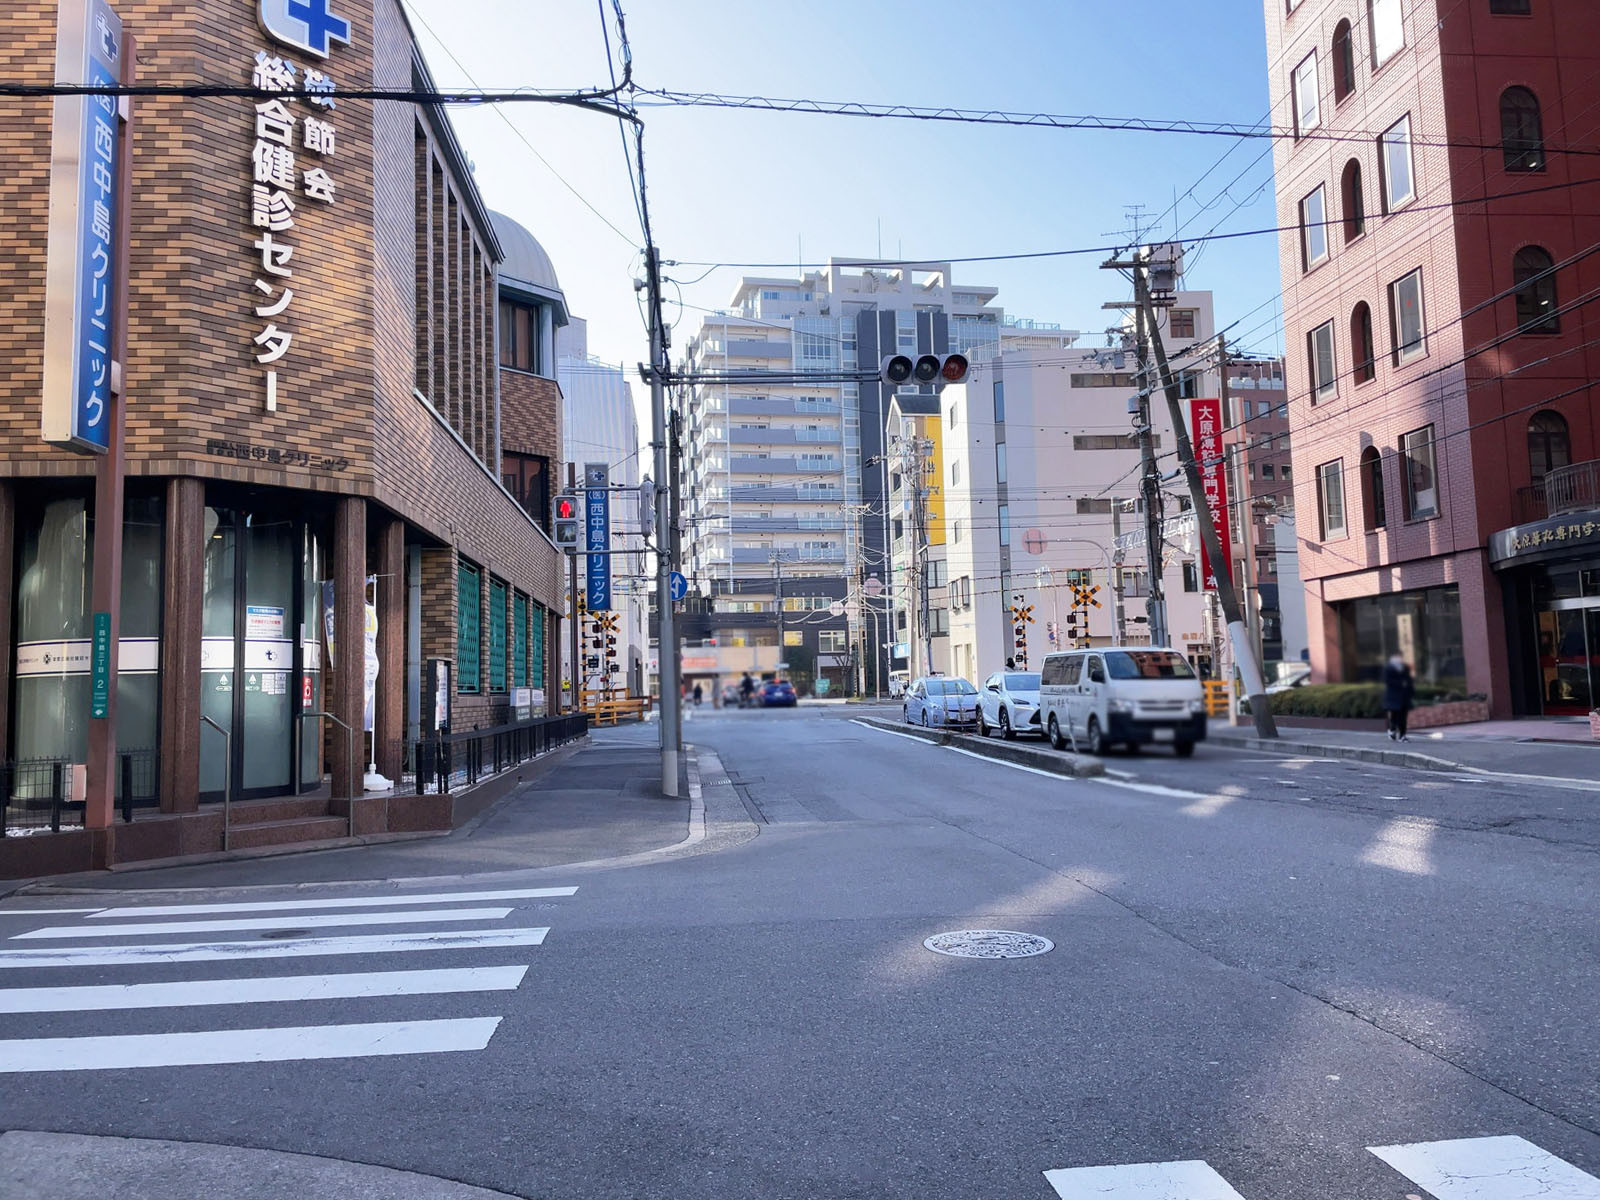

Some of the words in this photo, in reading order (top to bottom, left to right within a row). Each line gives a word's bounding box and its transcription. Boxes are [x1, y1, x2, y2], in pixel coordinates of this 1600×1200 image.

[252, 50, 296, 411] 総合健診センター
[97, 679, 104, 689] 2
